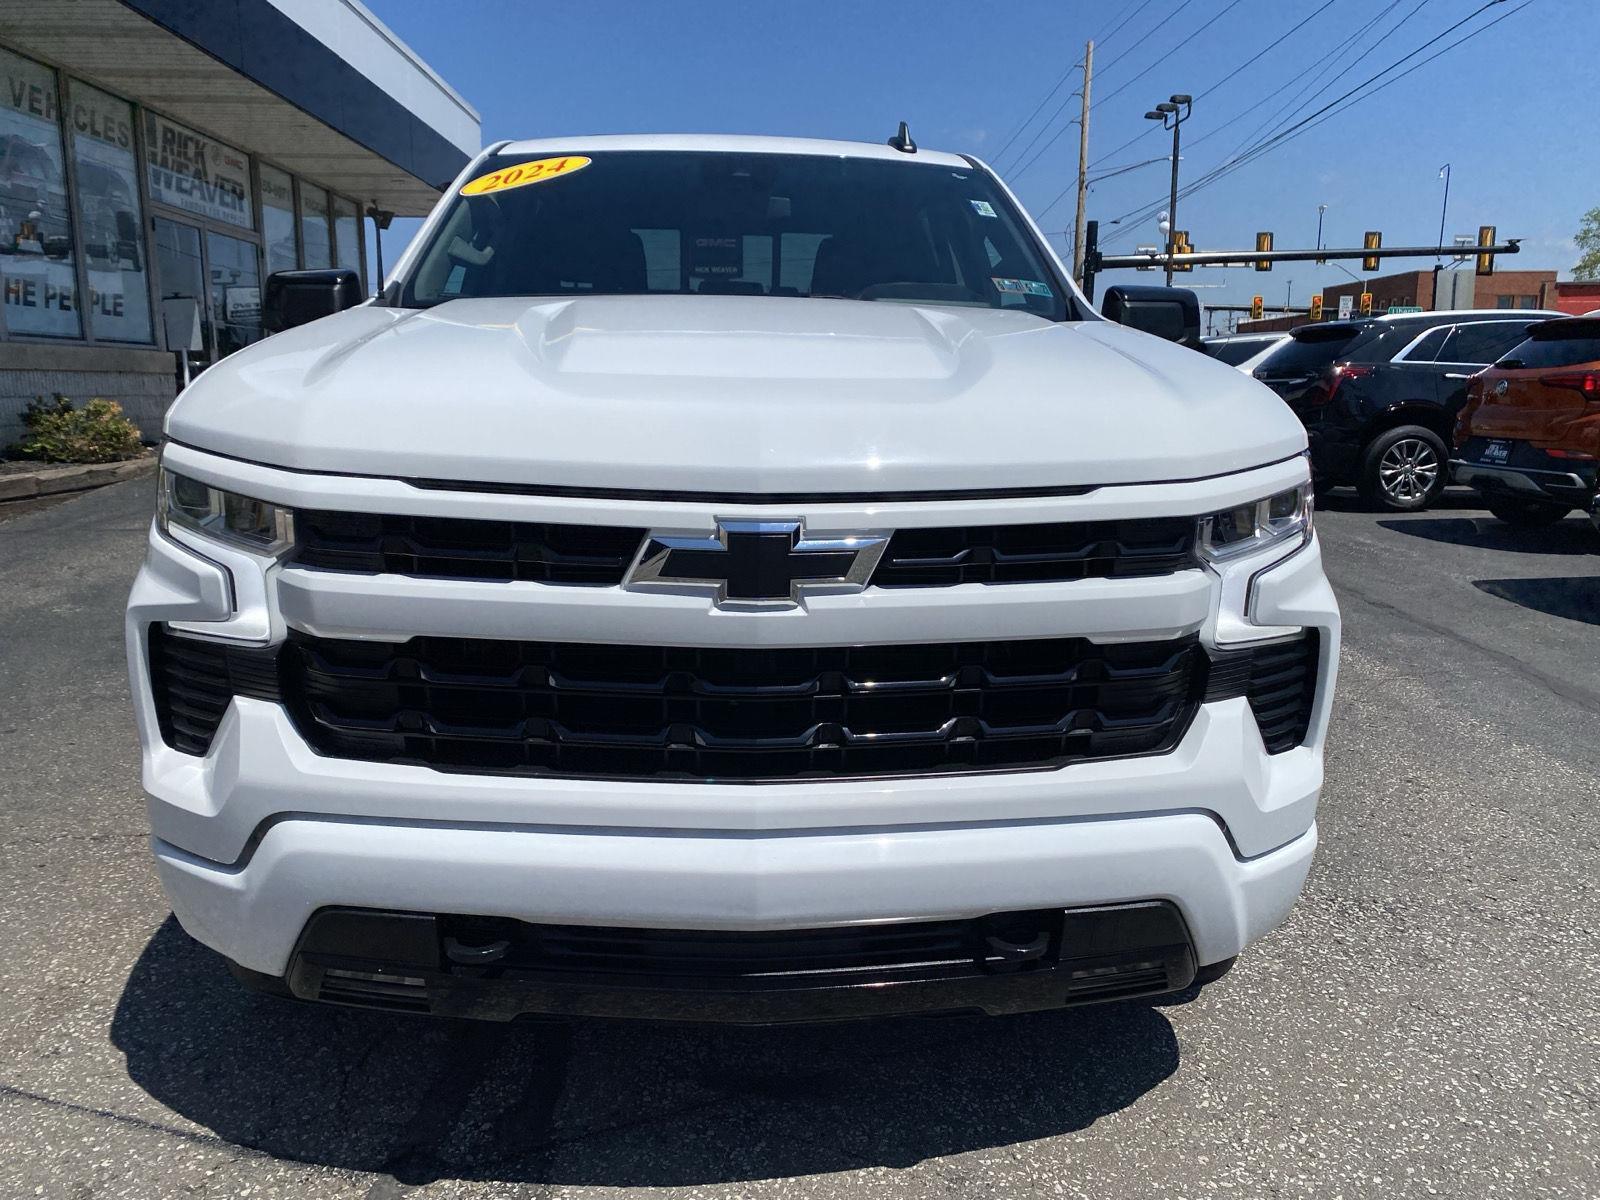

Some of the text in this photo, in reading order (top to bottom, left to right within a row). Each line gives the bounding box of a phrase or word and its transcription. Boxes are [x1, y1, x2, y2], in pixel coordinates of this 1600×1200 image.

[8, 77, 130, 147] VEHCLES
[161, 125, 208, 167] RICK
[150, 152, 245, 213] WEAVER
[481, 159, 568, 192] 2024
[696, 238, 736, 248] GMC
[44, 283, 124, 317] PEPLE
